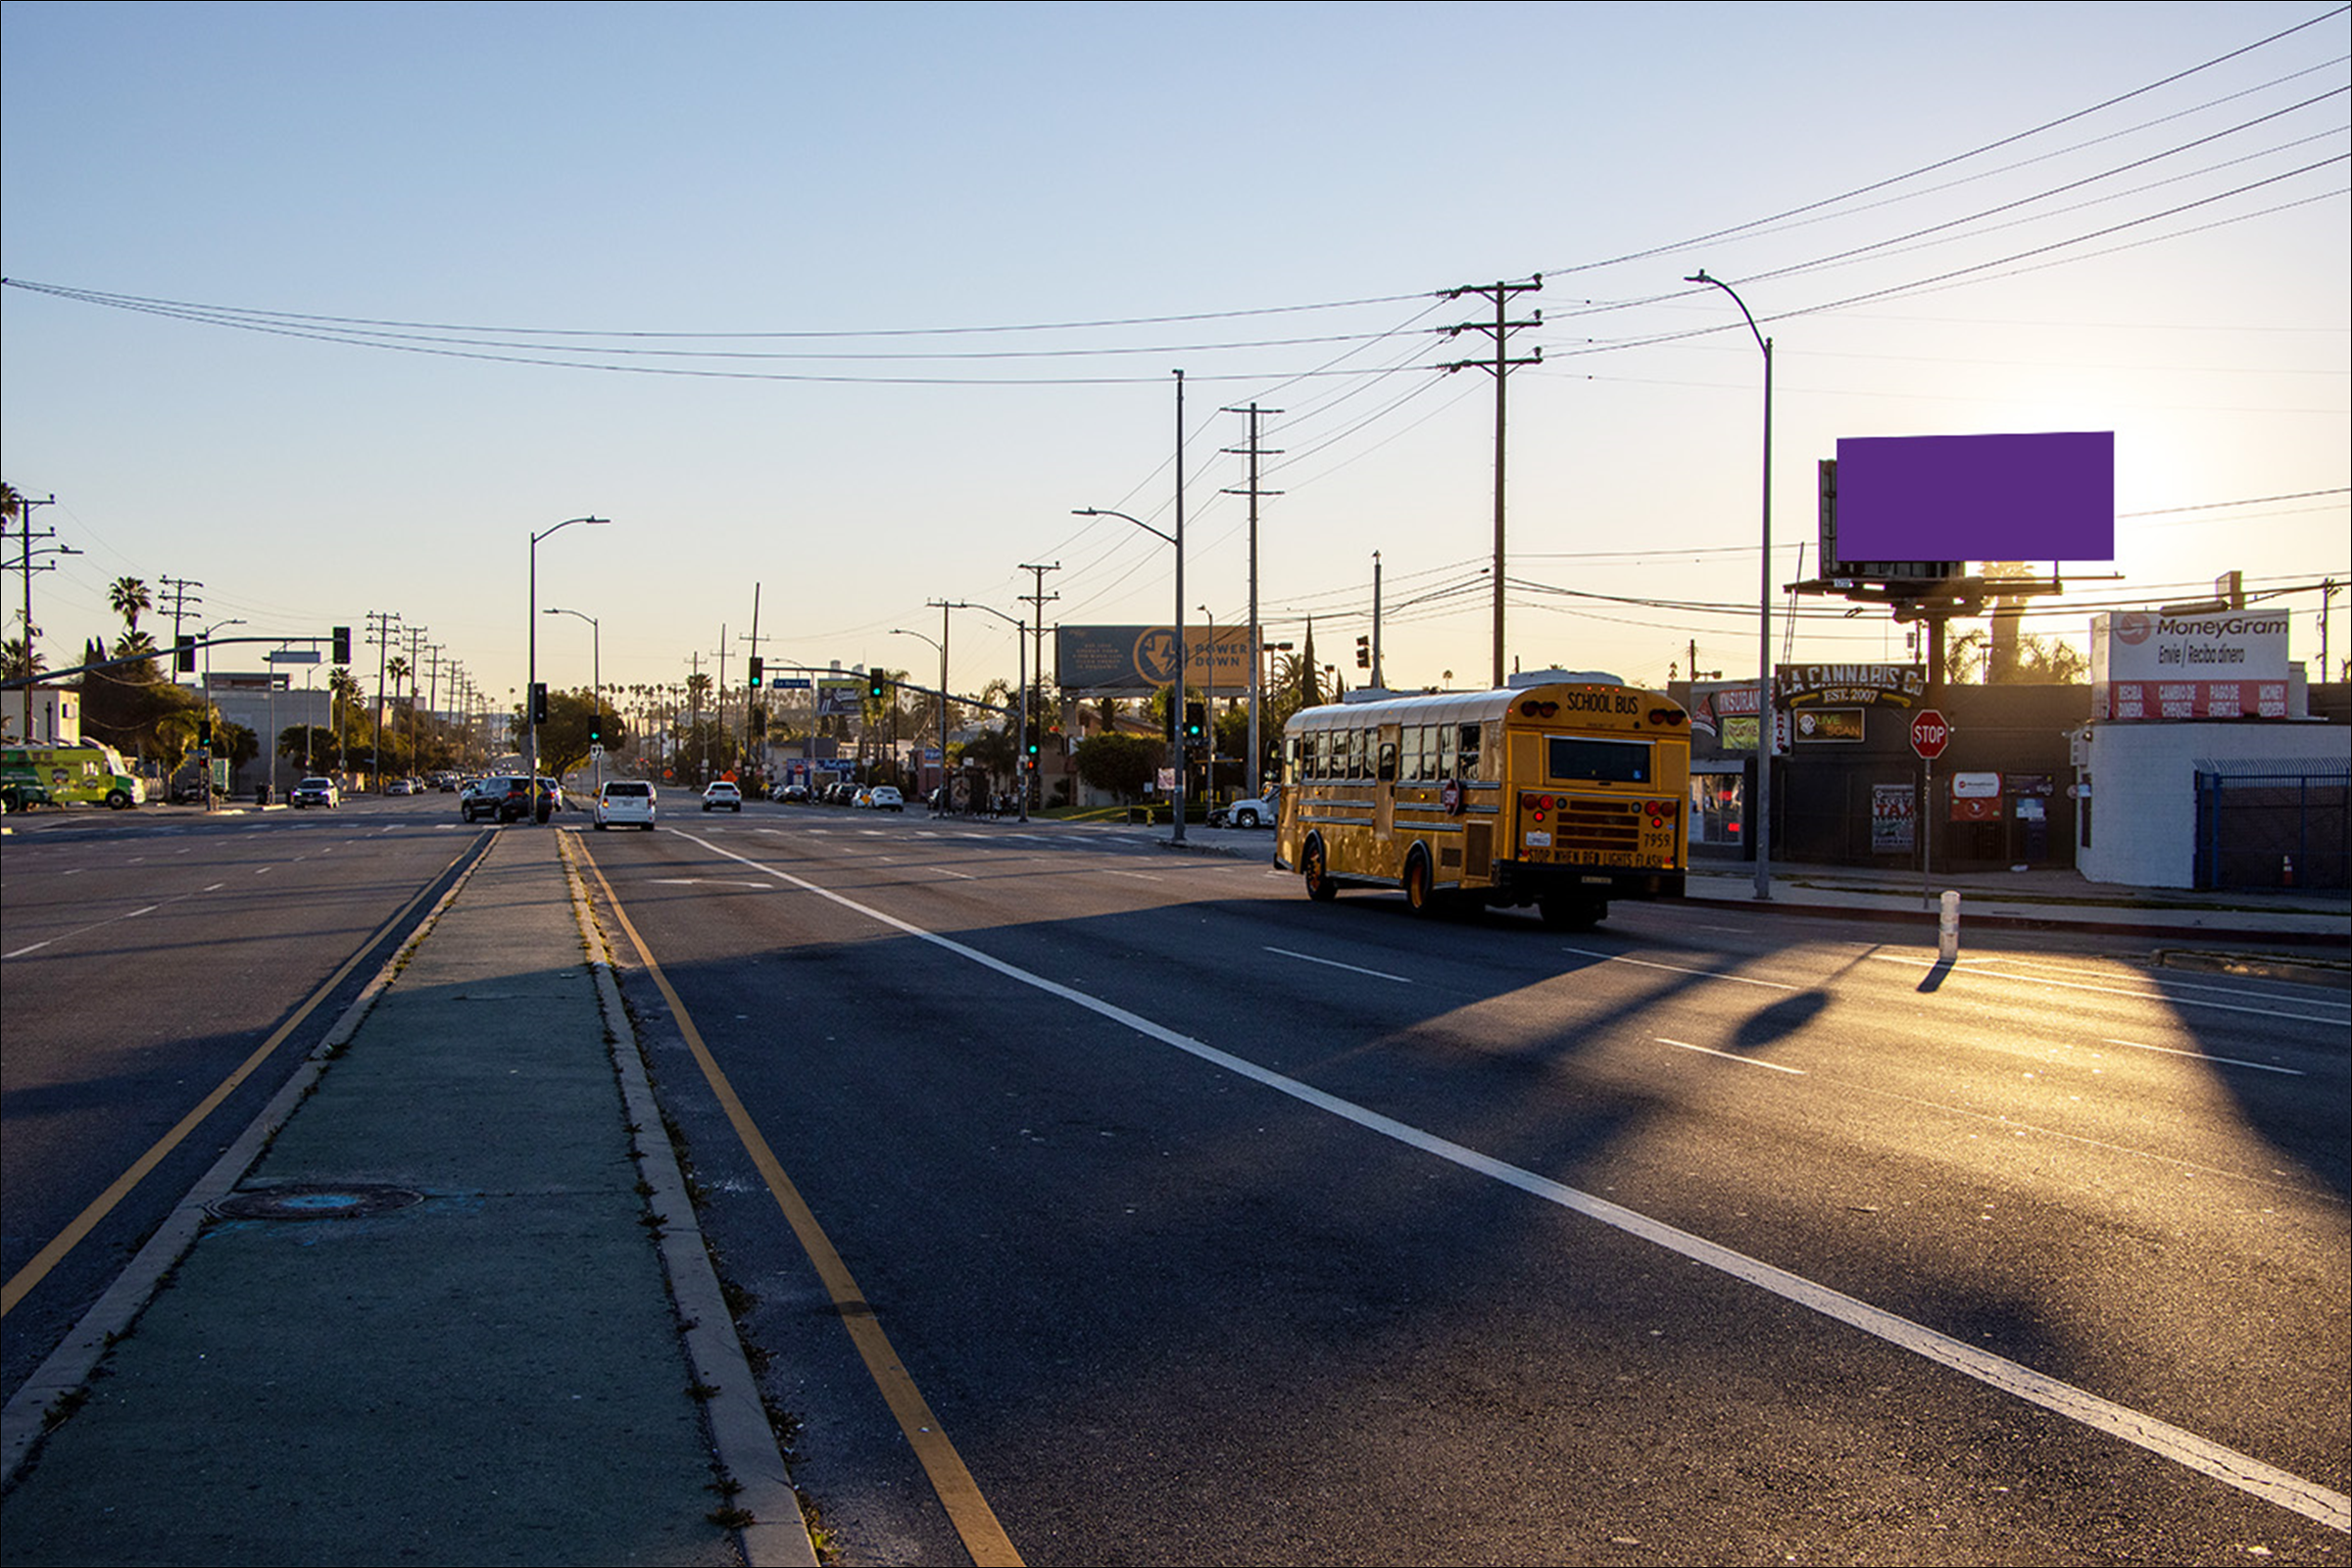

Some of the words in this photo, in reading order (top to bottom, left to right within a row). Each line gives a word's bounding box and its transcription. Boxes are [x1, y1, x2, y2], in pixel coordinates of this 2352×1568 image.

[2157, 619, 2288, 638] MoneyGram
[1195, 643, 1248, 655] POWER
[1195, 657, 1240, 667] DOWN
[1778, 668, 1805, 697] LA
[1807, 665, 1901, 689] CANNABIS
[1851, 689, 1879, 704] 2007
[2259, 685, 2284, 701] MONEY
[1567, 692, 1612, 713] SCHOOL
[1615, 695, 1638, 715] BUS
[1815, 714, 1841, 725] LIVE
[1826, 725, 1860, 736] SCAN
[1914, 725, 1945, 744] STOP
[1876, 805, 1913, 817] TAX
[1528, 850, 1551, 862] STOP
[1554, 850, 1580, 863] WHEN
[1583, 851, 1600, 865] RED
[1603, 853, 1633, 867] LIGHTS
[1636, 854, 1664, 869] FLASH
